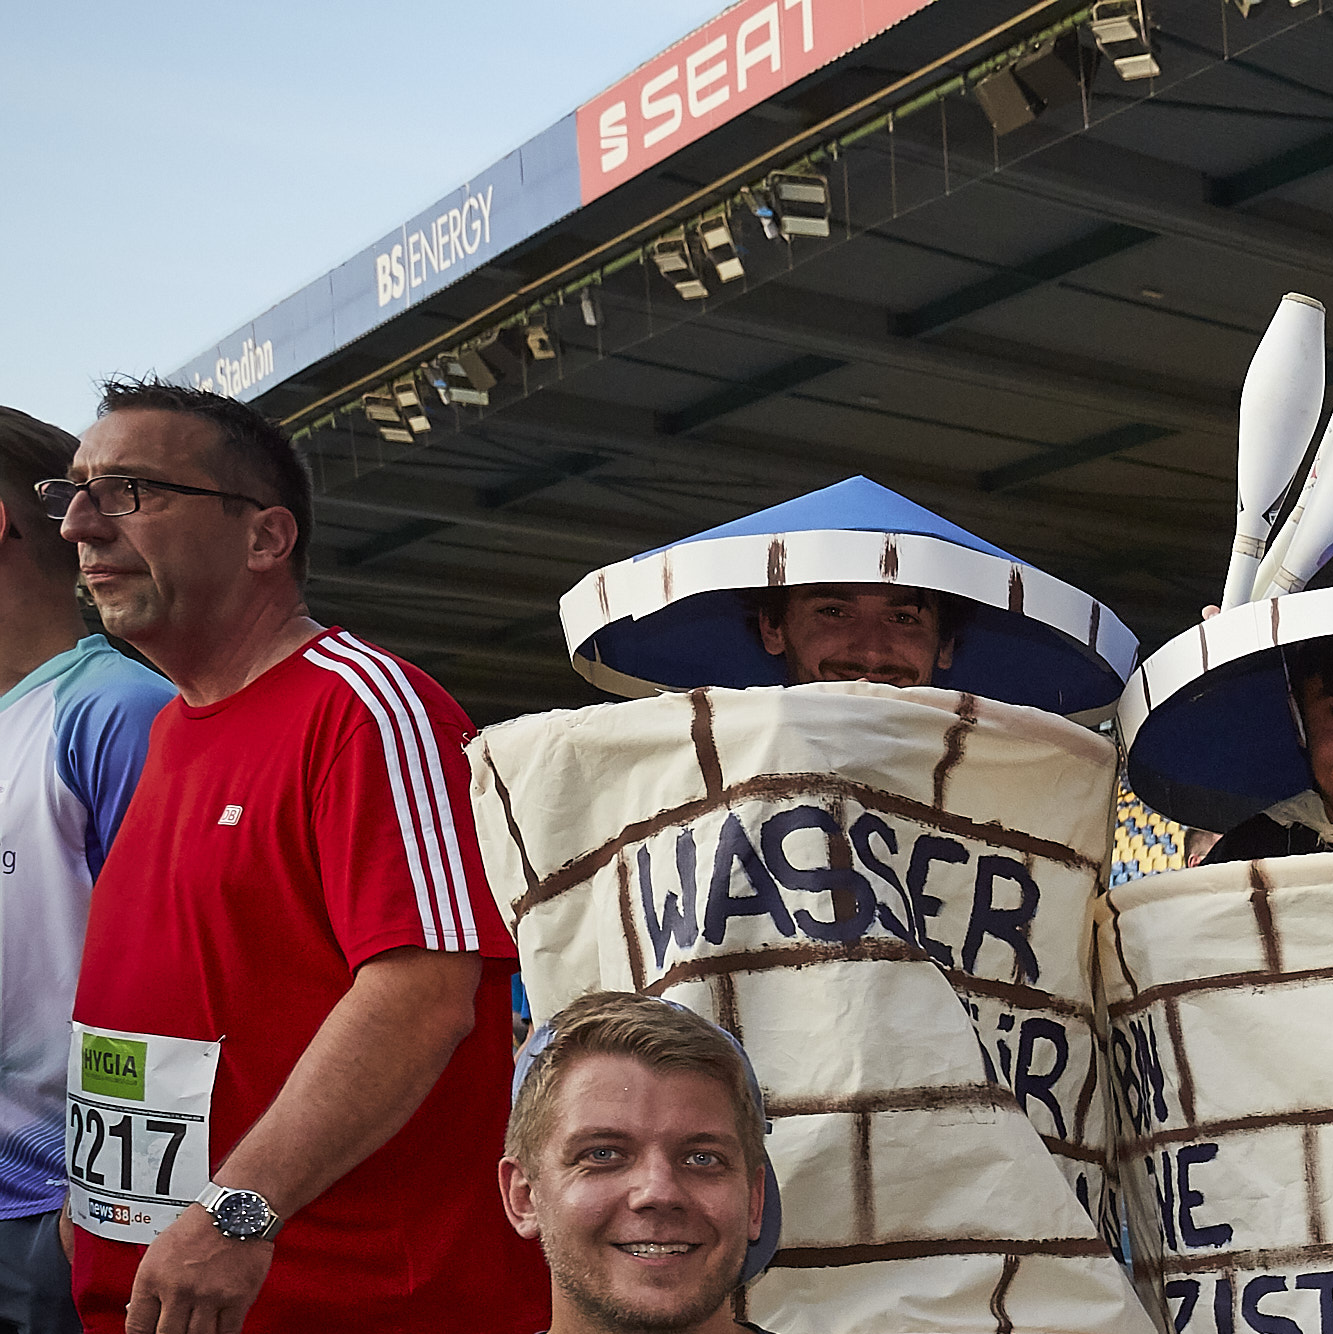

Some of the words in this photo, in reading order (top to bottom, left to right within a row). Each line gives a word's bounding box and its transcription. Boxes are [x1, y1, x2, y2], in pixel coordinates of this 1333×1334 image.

[641, 0, 814, 149] SEAT
[637, 804, 1041, 984] WASSER
[84, 1047, 138, 1078] HYGIA
[70, 1102, 188, 1197] 2217
[89, 1199, 152, 1225] news38.de
